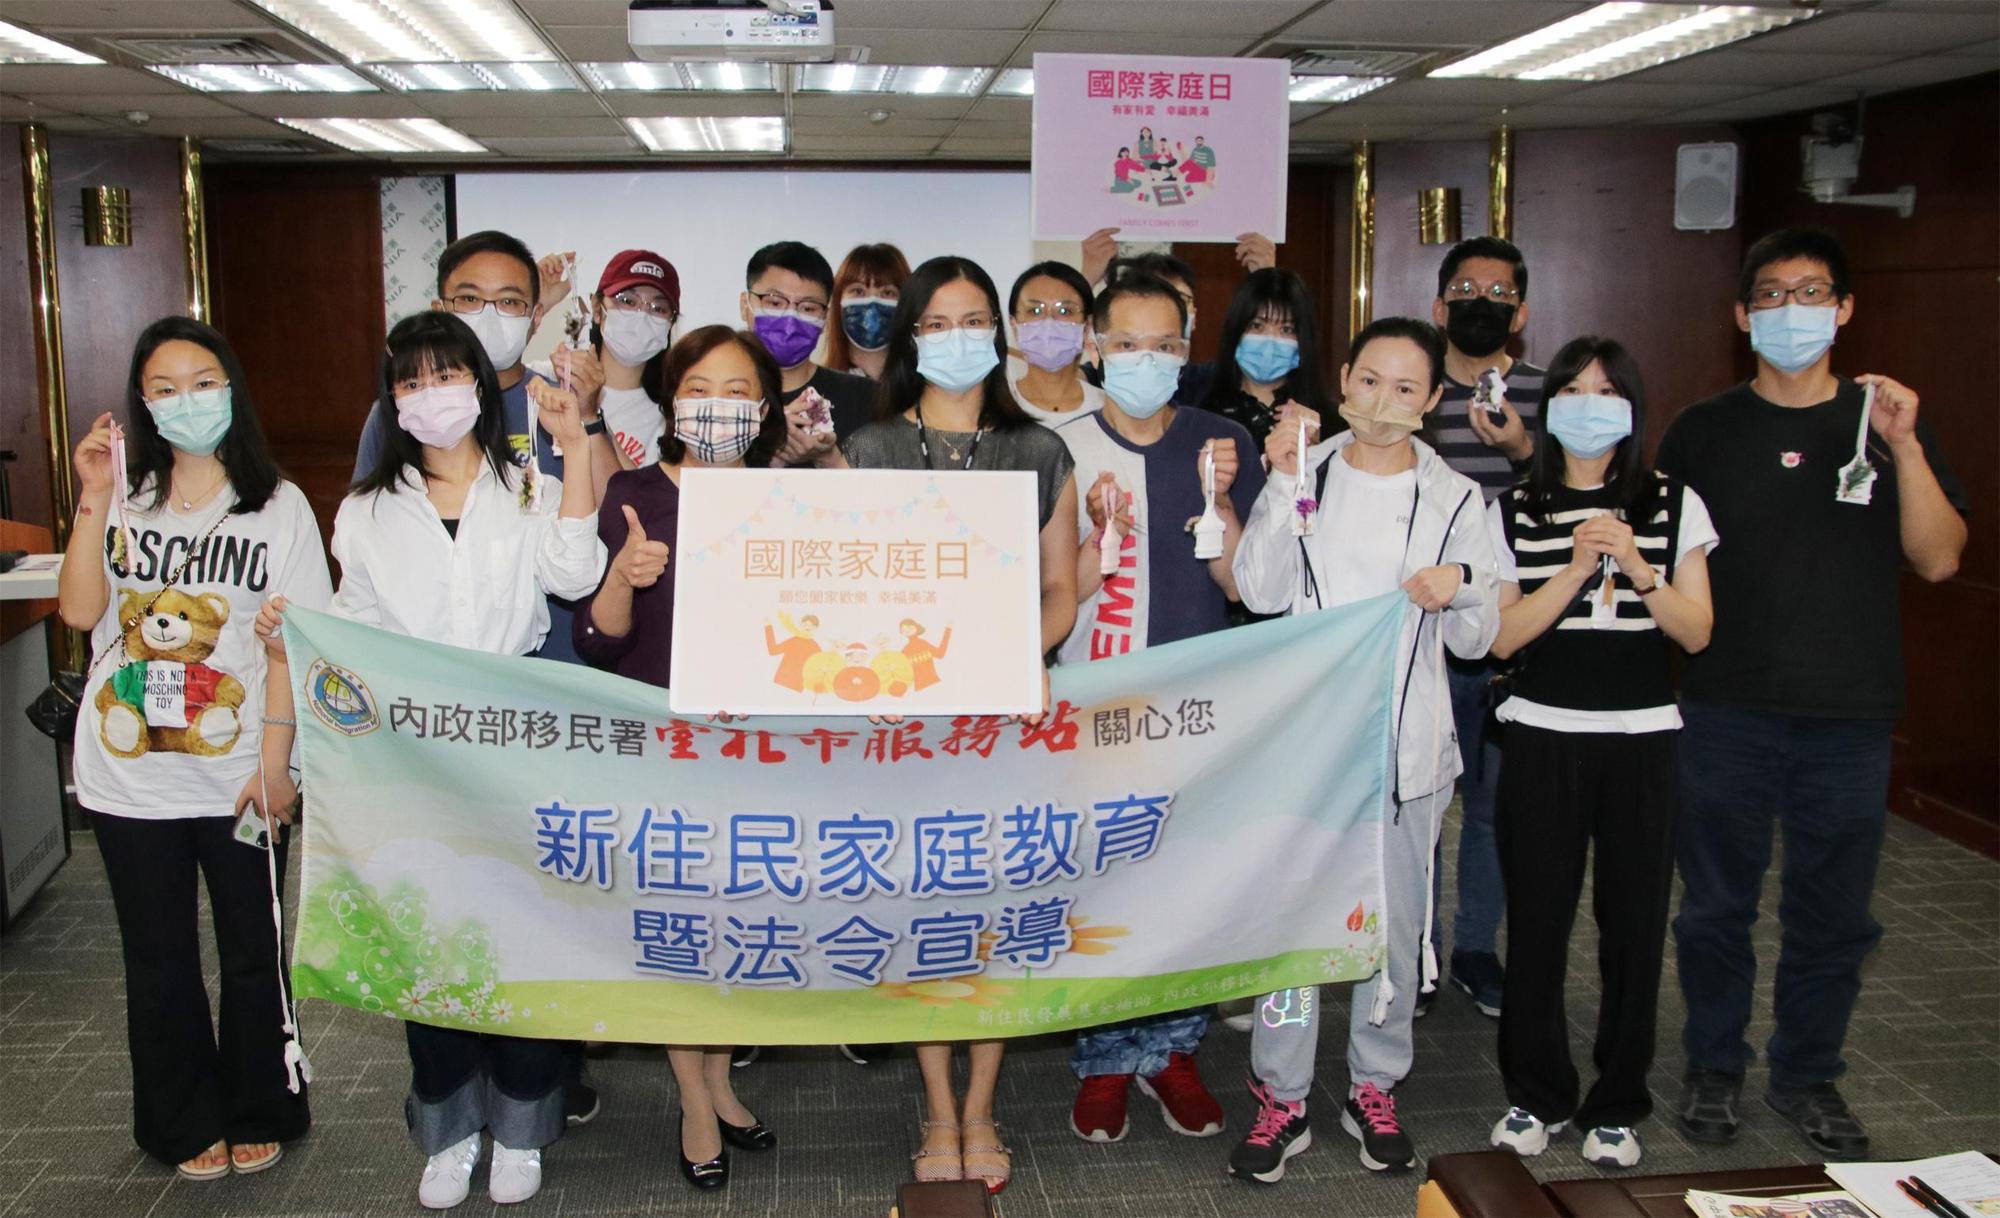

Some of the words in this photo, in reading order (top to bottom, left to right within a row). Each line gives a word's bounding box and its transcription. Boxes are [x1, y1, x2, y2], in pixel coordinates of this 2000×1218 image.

[1087, 70, 1232, 101] 國際家庭日
[382, 211, 405, 233] NIA
[1119, 218, 1147, 228] FAMILY
[1149, 219, 1176, 228] COMES
[1177, 219, 1199, 228] FIRST
[383, 248, 406, 270] NIA
[385, 284, 408, 305] NIA
[743, 538, 969, 580] 國際家庭日
[878, 590, 938, 605] 幸福美滿
[136, 669, 154, 682] THIS
[157, 669, 166, 682] IS
[170, 669, 187, 682] NOT
[190, 671, 197, 682] A
[143, 683, 188, 696] MOSCHINO
[155, 698, 173, 709] TOY
[533, 793, 1171, 897] 新住民家庭教育
[632, 896, 1073, 985] 暨法令宣導
